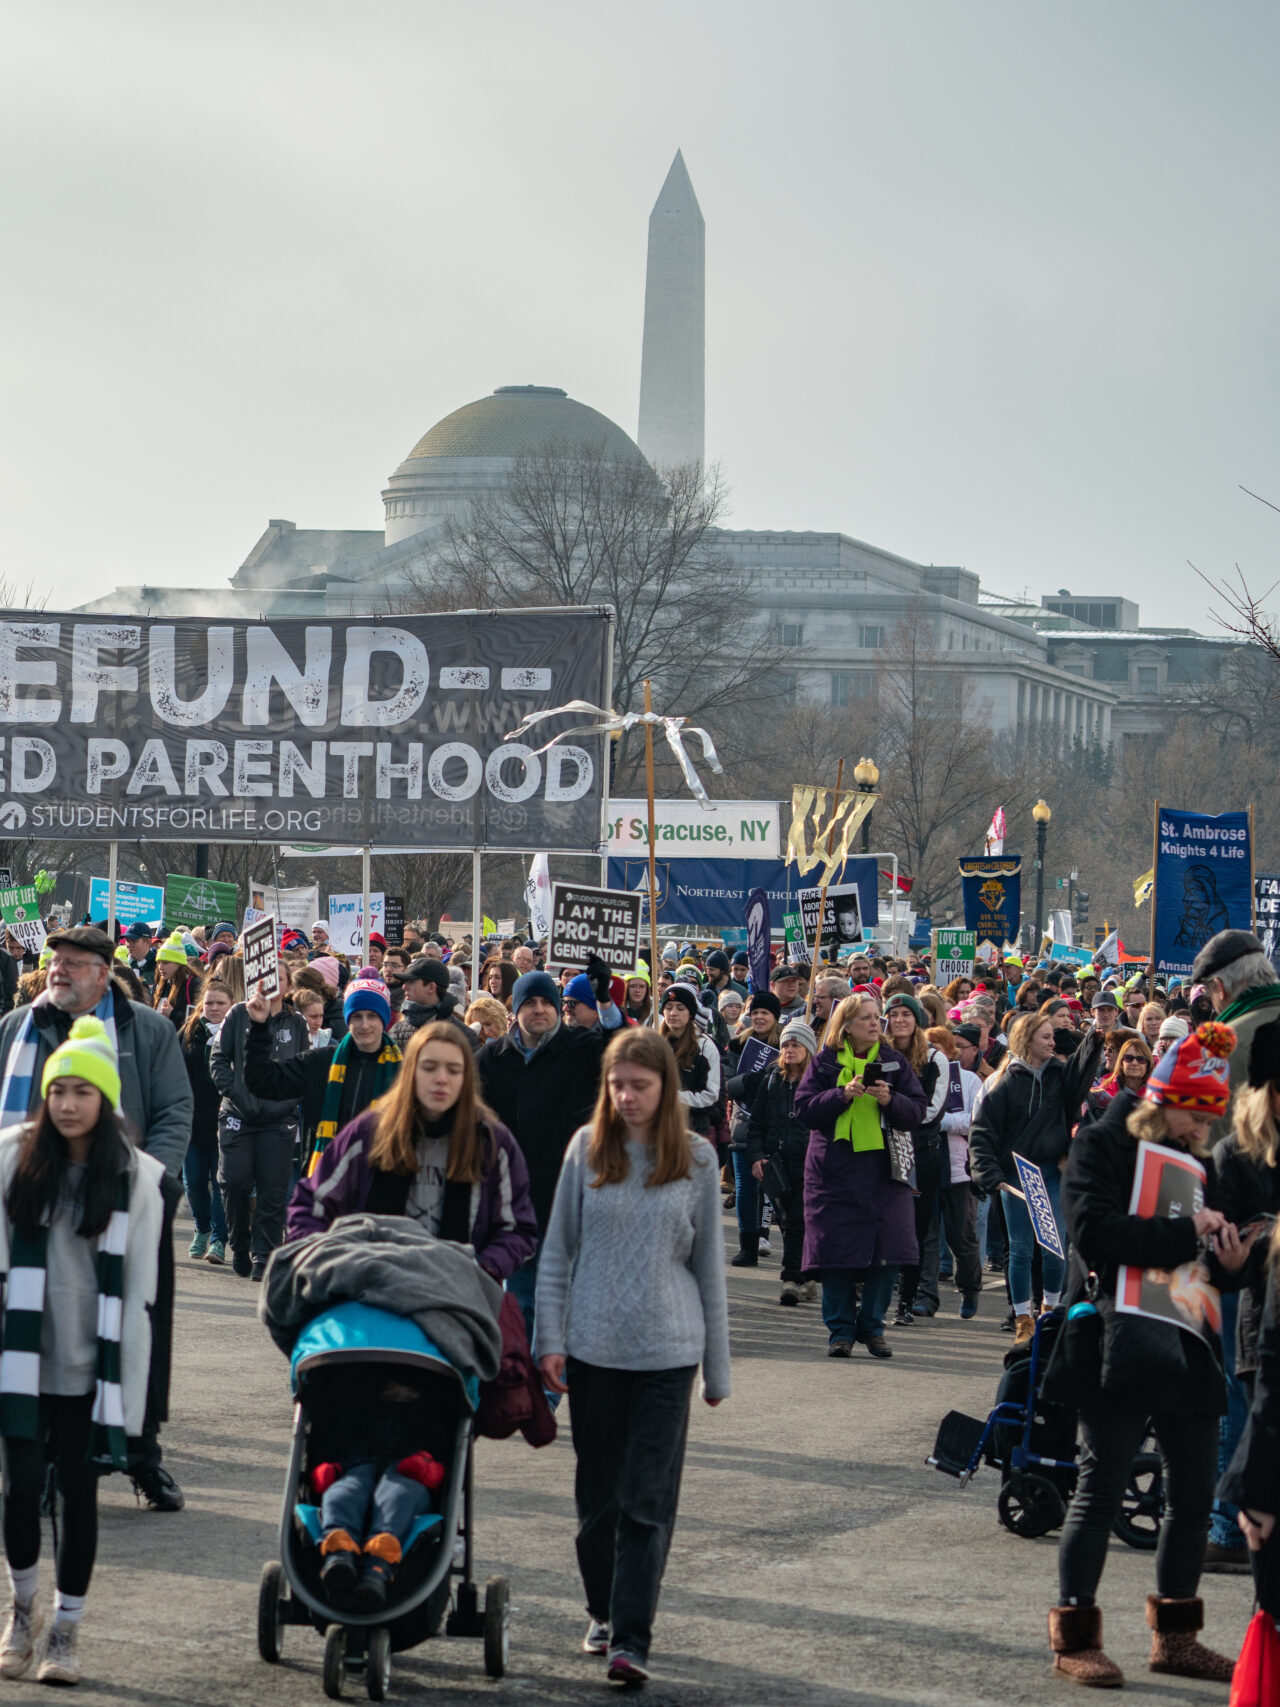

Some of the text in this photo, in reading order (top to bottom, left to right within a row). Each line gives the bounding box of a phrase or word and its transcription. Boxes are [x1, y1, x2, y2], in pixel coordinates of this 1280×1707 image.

[86, 737, 594, 802] PARENTHOOD
[31, 805, 320, 832] STUDENTSFORLIFE.ORG
[629, 818, 734, 846] Syracuse,
[740, 820, 771, 842] NY
[1161, 821, 1247, 841] St. Ambrose
[1161, 841, 1245, 859] Knights 4 Life
[0, 887, 37, 908] LOVE LIFE
[801, 890, 819, 901] FACE
[329, 897, 355, 915] Human
[358, 897, 382, 912] Les
[559, 902, 633, 925] I AM THE
[805, 909, 836, 927] KILS
[553, 919, 637, 947] PRO-LIFE
[938, 931, 974, 946] LOVE LIFE
[249, 941, 260, 959] AM
[260, 934, 273, 952] THE
[940, 959, 970, 974] CHOOSE
[225, 1116, 241, 1131] 35
[1031, 1172, 1059, 1249] DEFUND
